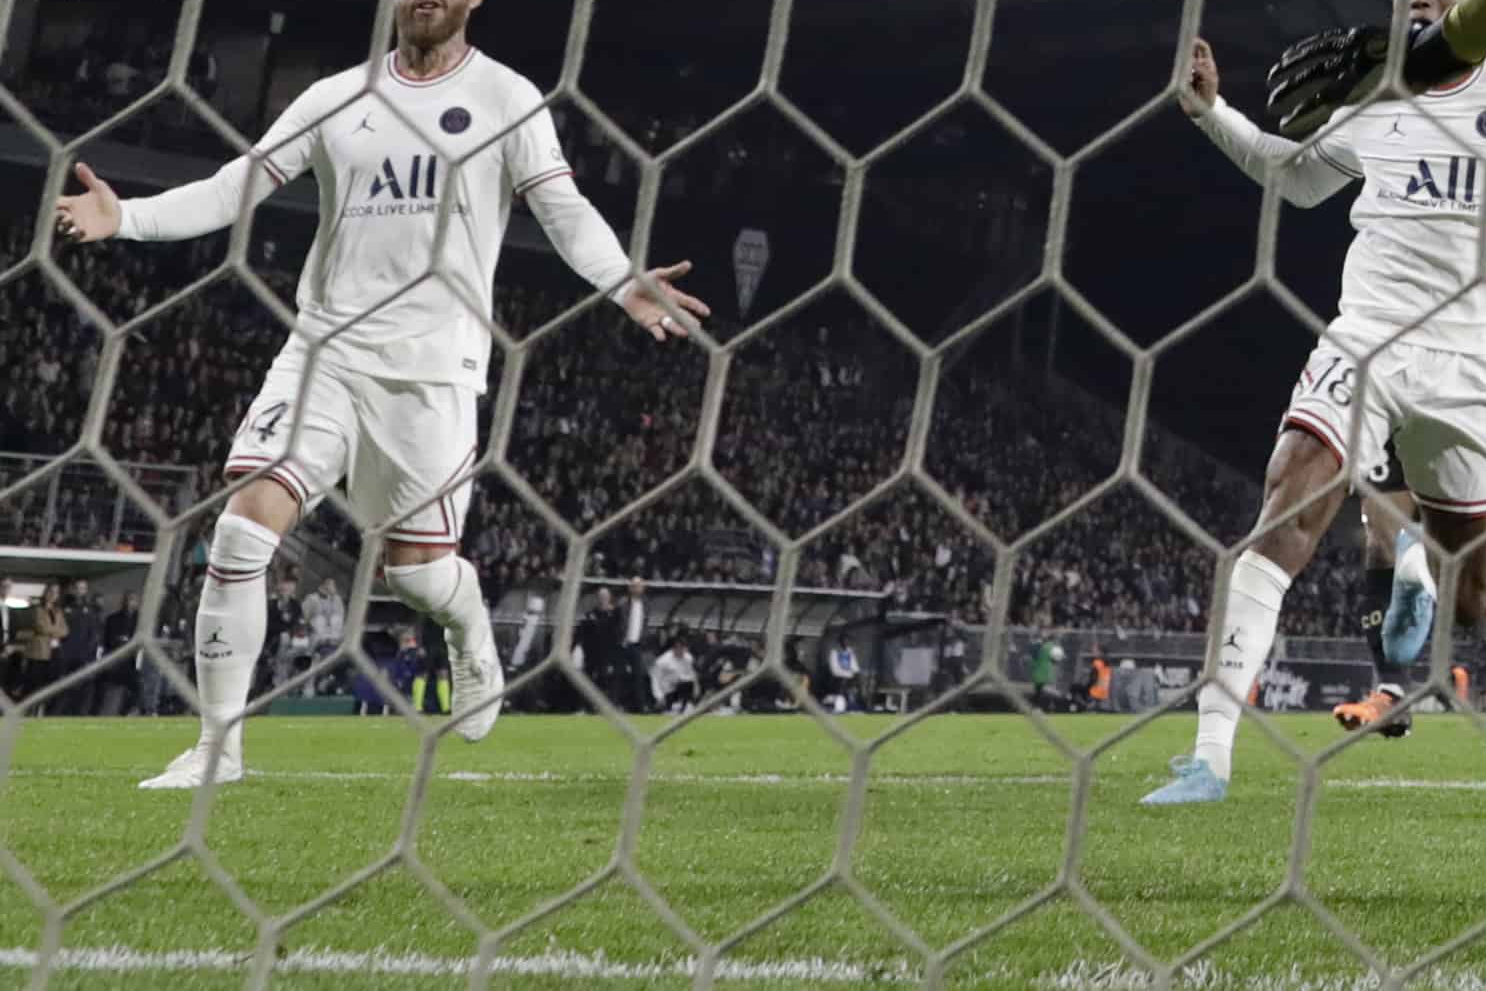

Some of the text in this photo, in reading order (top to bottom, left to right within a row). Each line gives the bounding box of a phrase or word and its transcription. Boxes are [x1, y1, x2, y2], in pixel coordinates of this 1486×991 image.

[377, 203, 407, 216] LIVE
[1312, 356, 1359, 408] 18
[256, 400, 289, 443] 4
